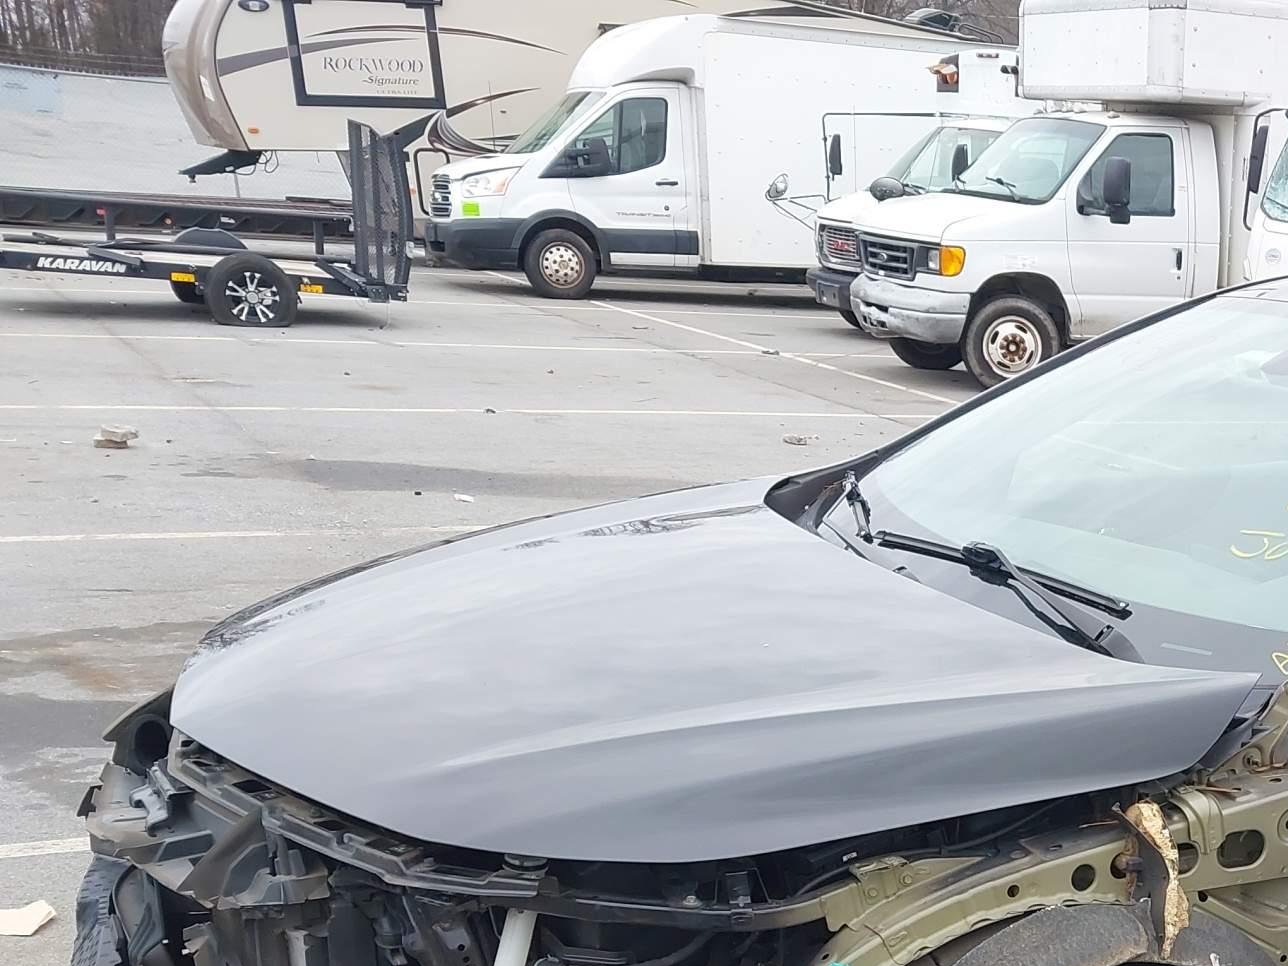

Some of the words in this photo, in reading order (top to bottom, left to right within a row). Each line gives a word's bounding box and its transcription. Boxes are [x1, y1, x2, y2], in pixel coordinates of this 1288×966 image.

[323, 56, 424, 74] ROCKWOOD
[362, 74, 420, 87] Signature
[36, 256, 128, 274] KARAVAN
